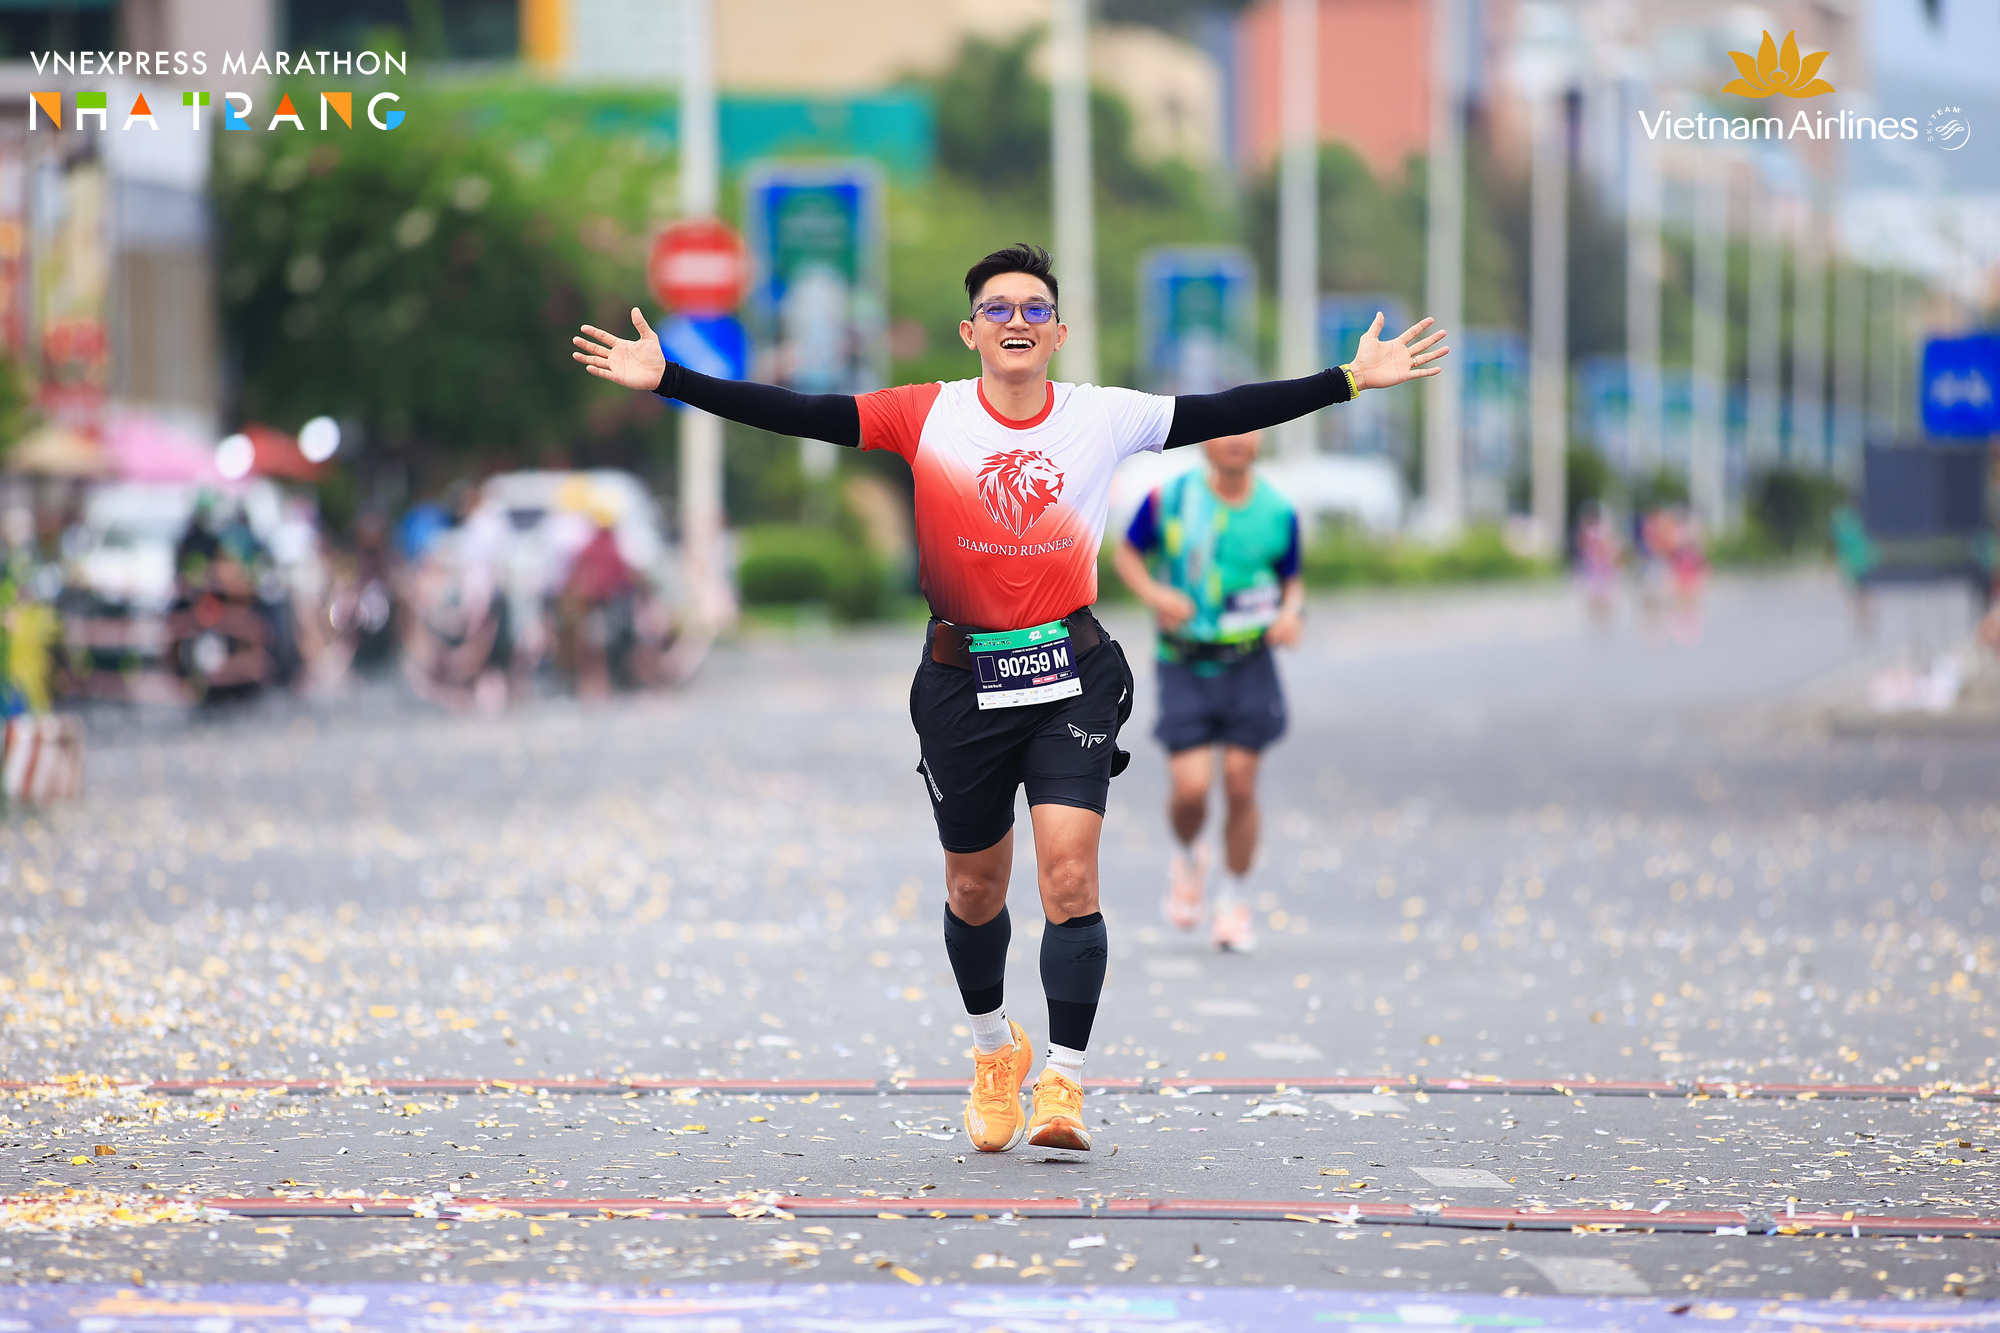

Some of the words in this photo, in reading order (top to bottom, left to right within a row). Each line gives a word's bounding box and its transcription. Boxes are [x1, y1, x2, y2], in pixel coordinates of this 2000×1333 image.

[957, 536, 1017, 556] DIAMOND
[1020, 535, 1074, 556] RUNNERS
[998, 651, 1051, 678] 90259
[1052, 646, 1069, 669] M
